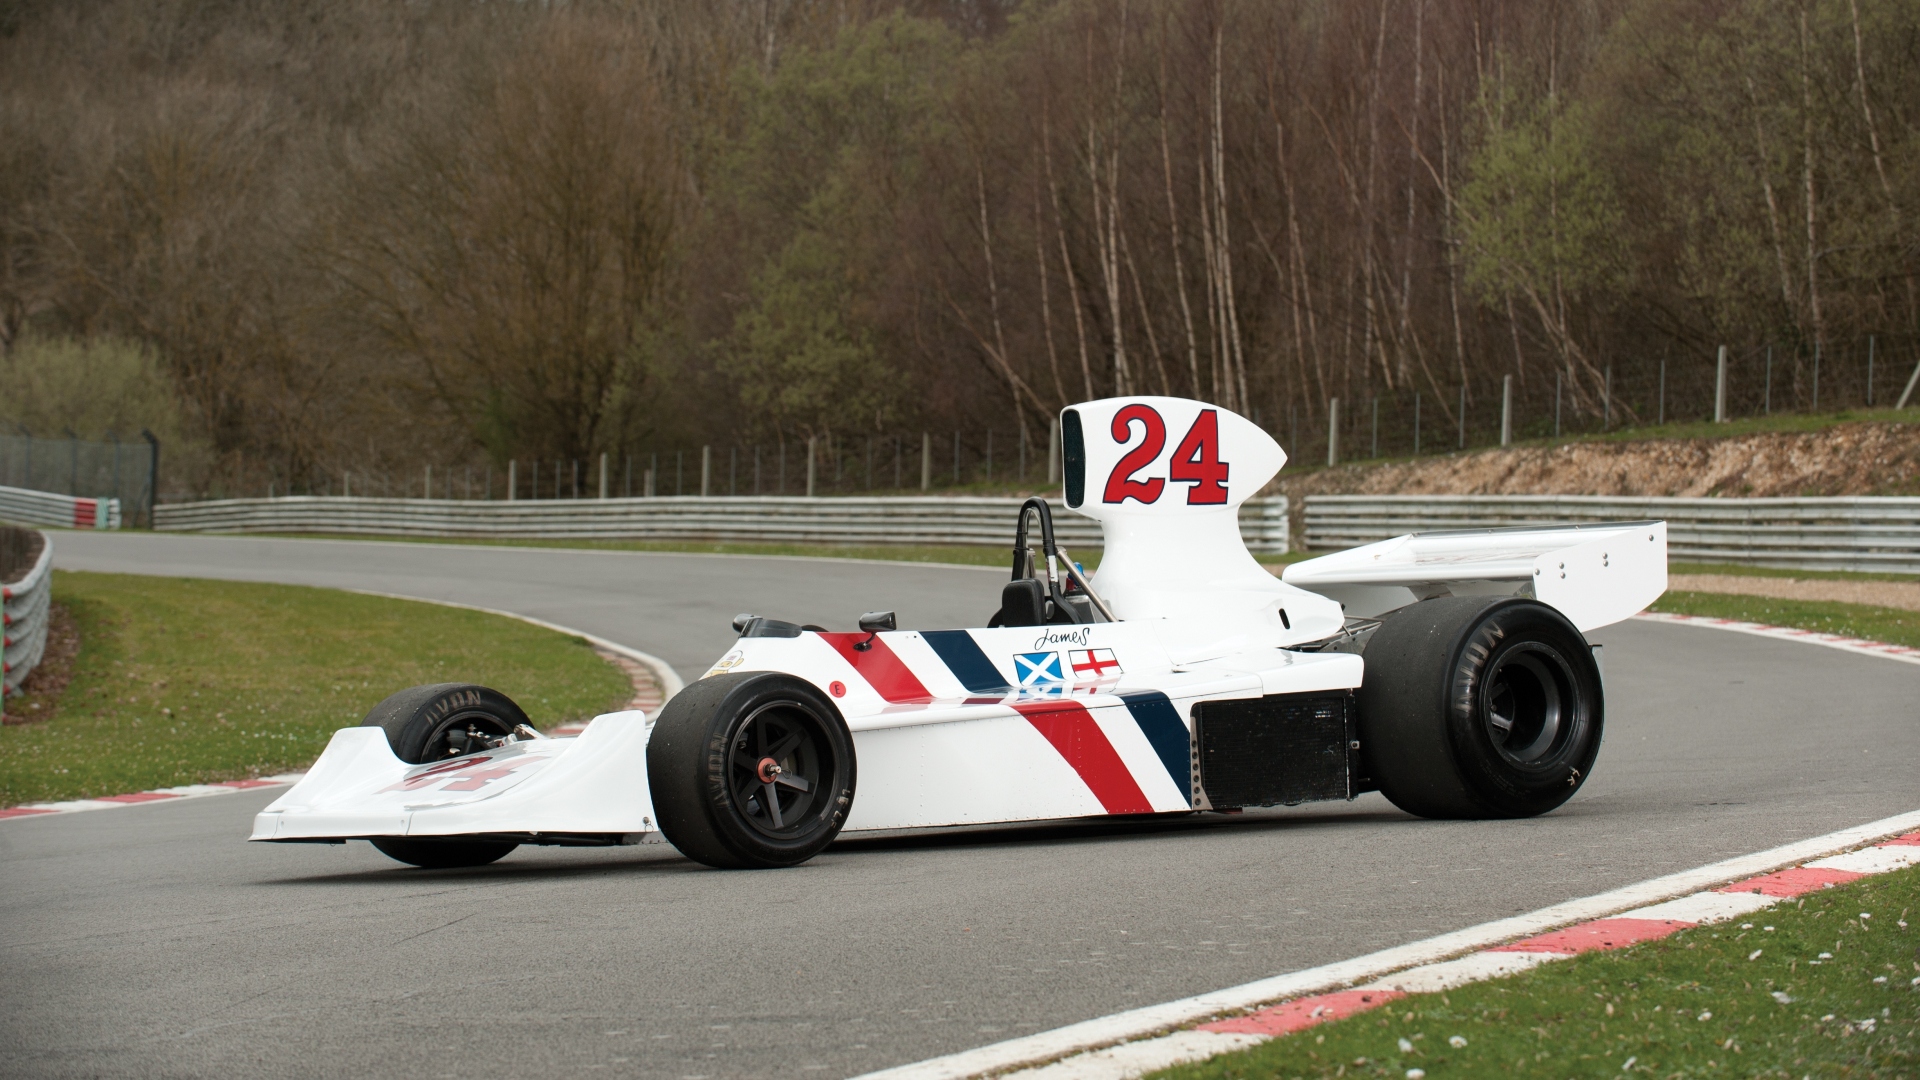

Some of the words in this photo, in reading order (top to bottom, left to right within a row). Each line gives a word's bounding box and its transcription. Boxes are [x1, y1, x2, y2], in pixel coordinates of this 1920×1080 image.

[1102, 403, 1230, 506] 24
[424, 689, 481, 726] AVON
[1455, 619, 1504, 713] AVON
